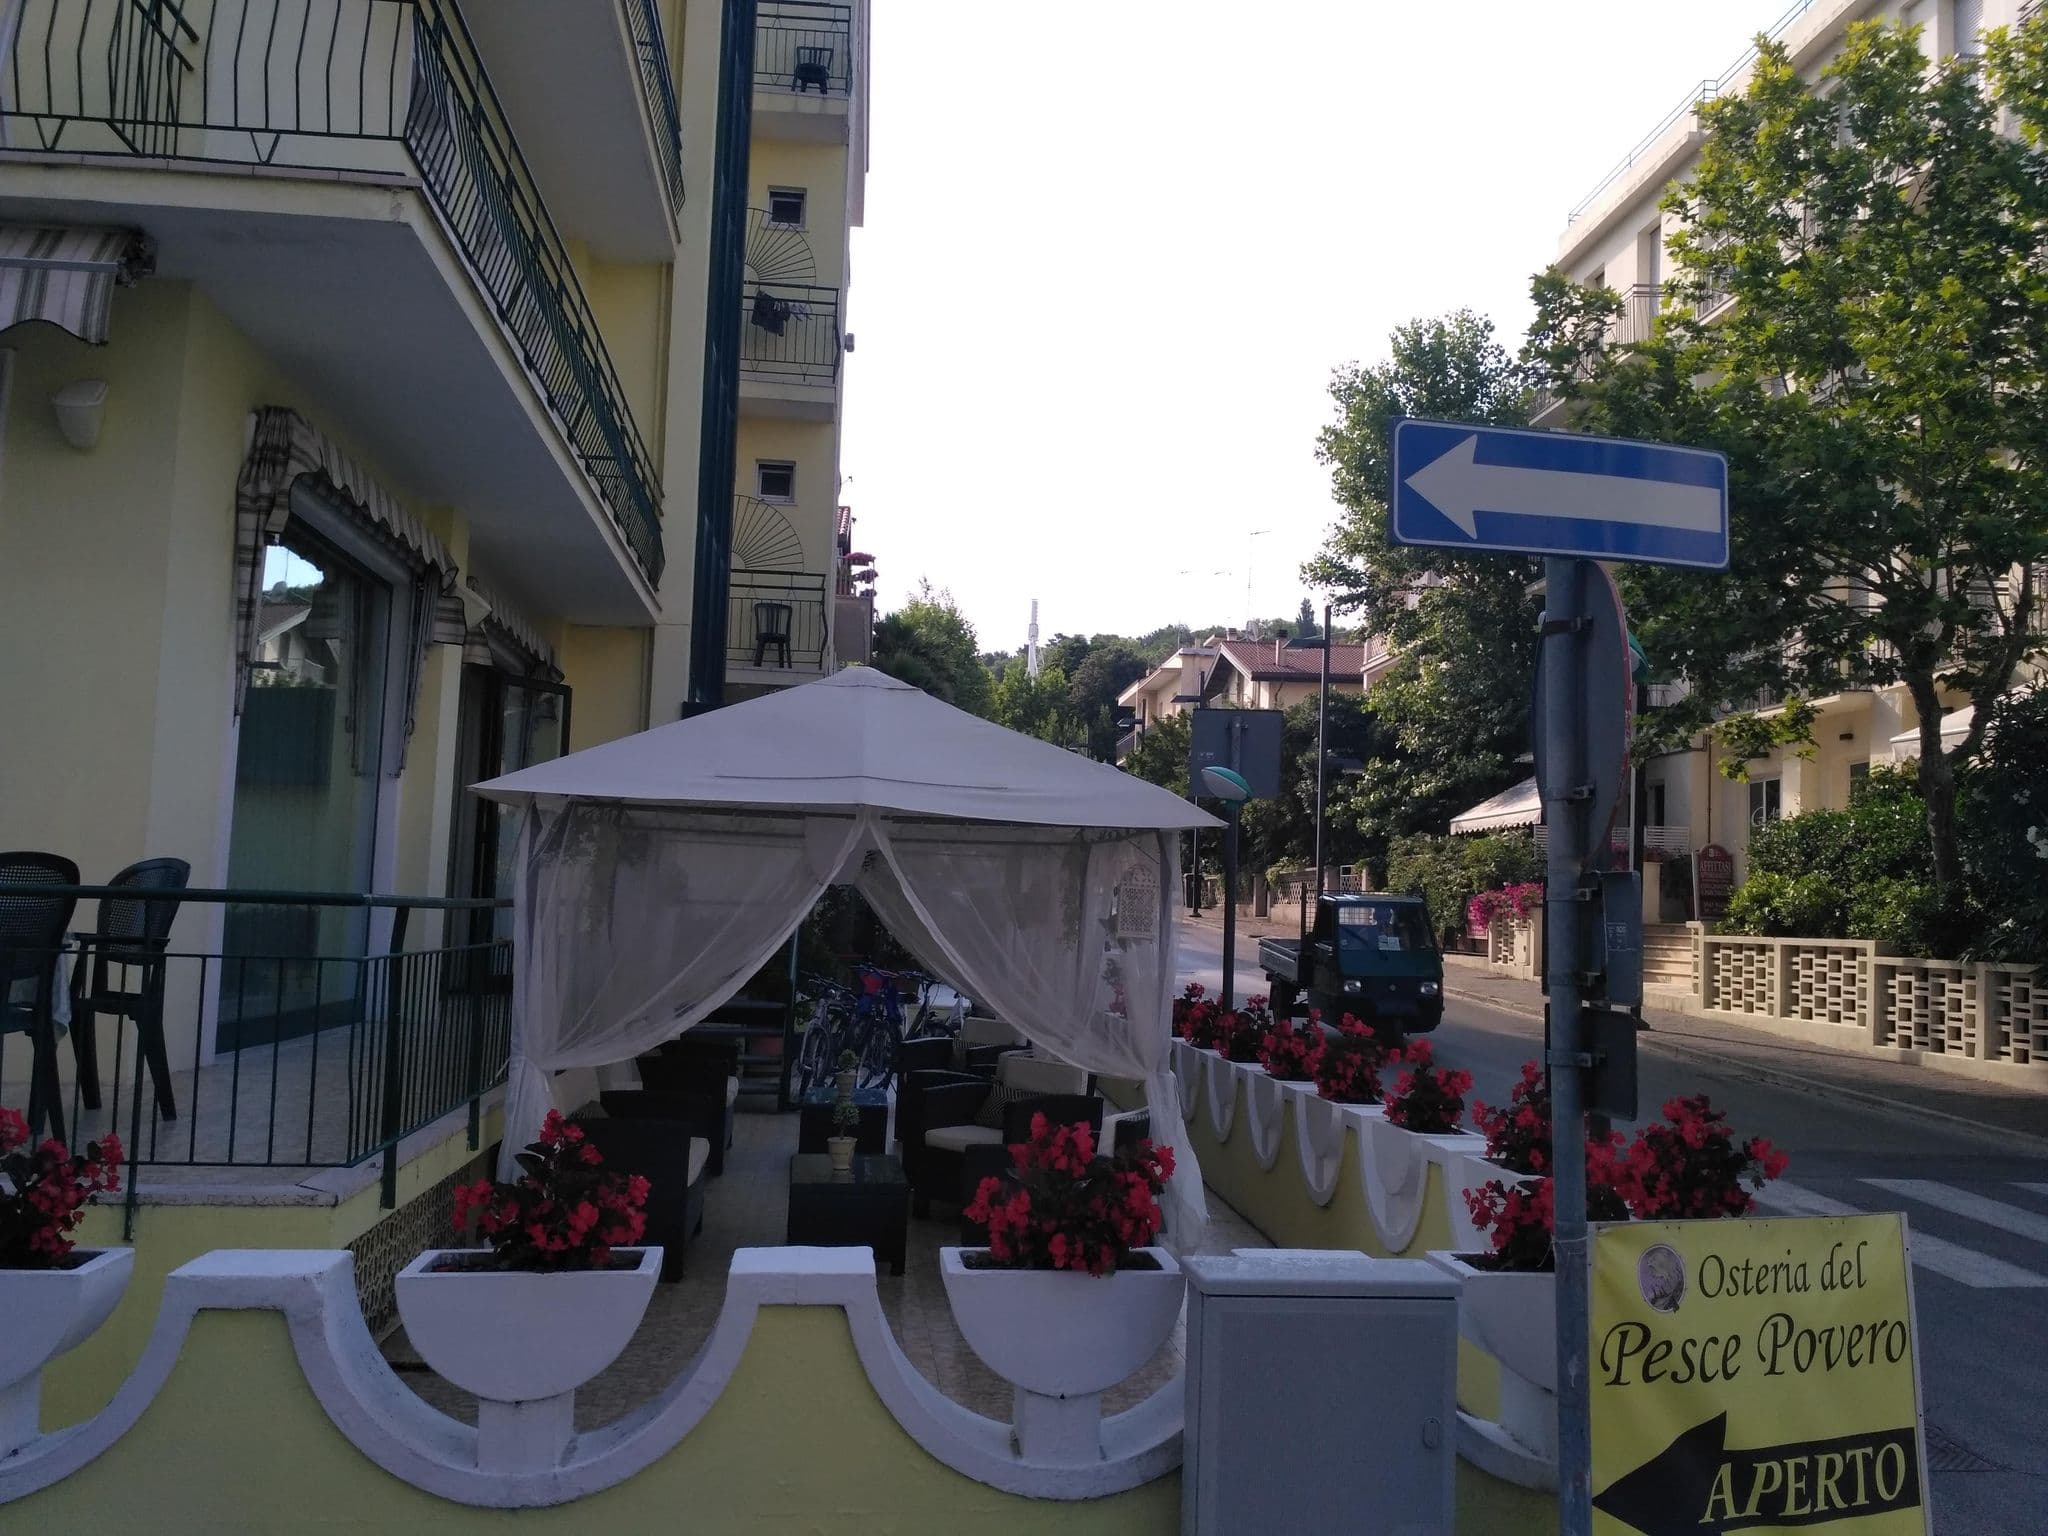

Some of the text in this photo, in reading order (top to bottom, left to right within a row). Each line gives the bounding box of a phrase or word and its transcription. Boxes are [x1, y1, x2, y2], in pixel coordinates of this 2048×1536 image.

[1698, 1240, 1868, 1298] Osteria del
[1600, 1312, 1907, 1386] Pesce Povero
[1698, 1442, 1906, 1524] APERTO
